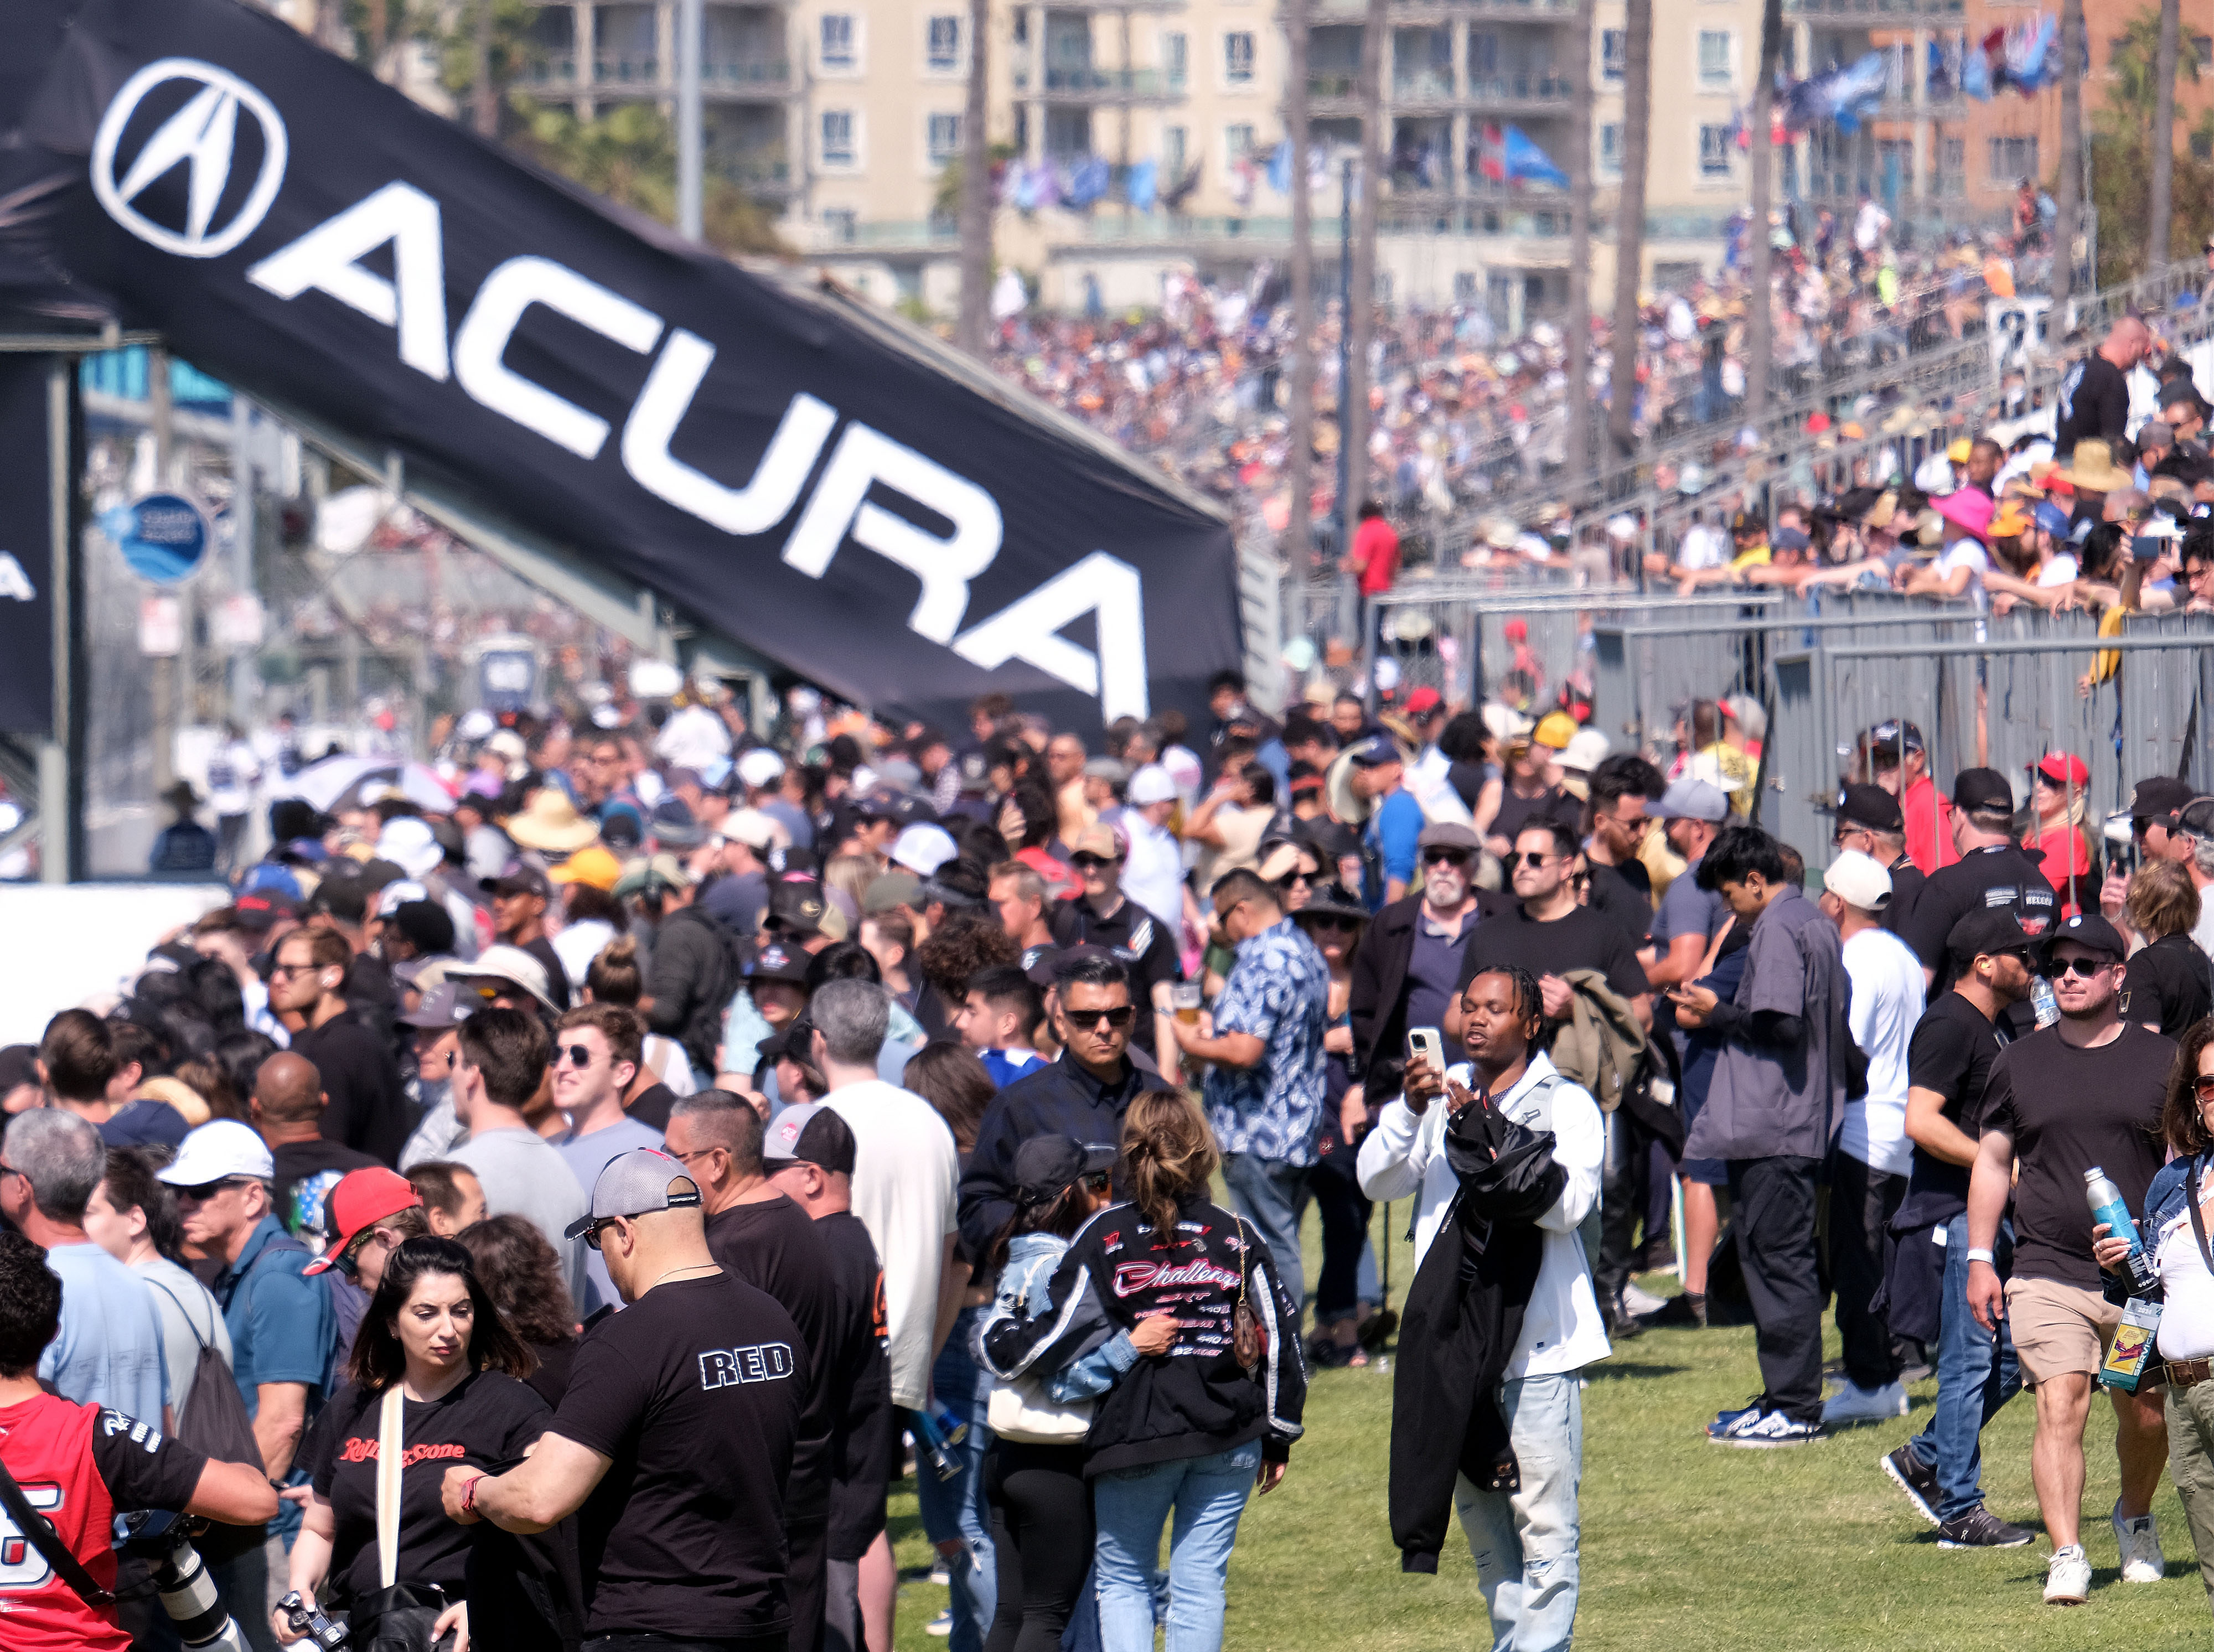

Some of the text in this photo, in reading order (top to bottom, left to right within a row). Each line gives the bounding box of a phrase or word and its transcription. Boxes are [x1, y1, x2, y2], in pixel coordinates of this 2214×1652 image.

[246, 179, 1149, 724] ACURA
[699, 1343, 794, 1391] RED
[2133, 1330, 2156, 1377] SERVICE
